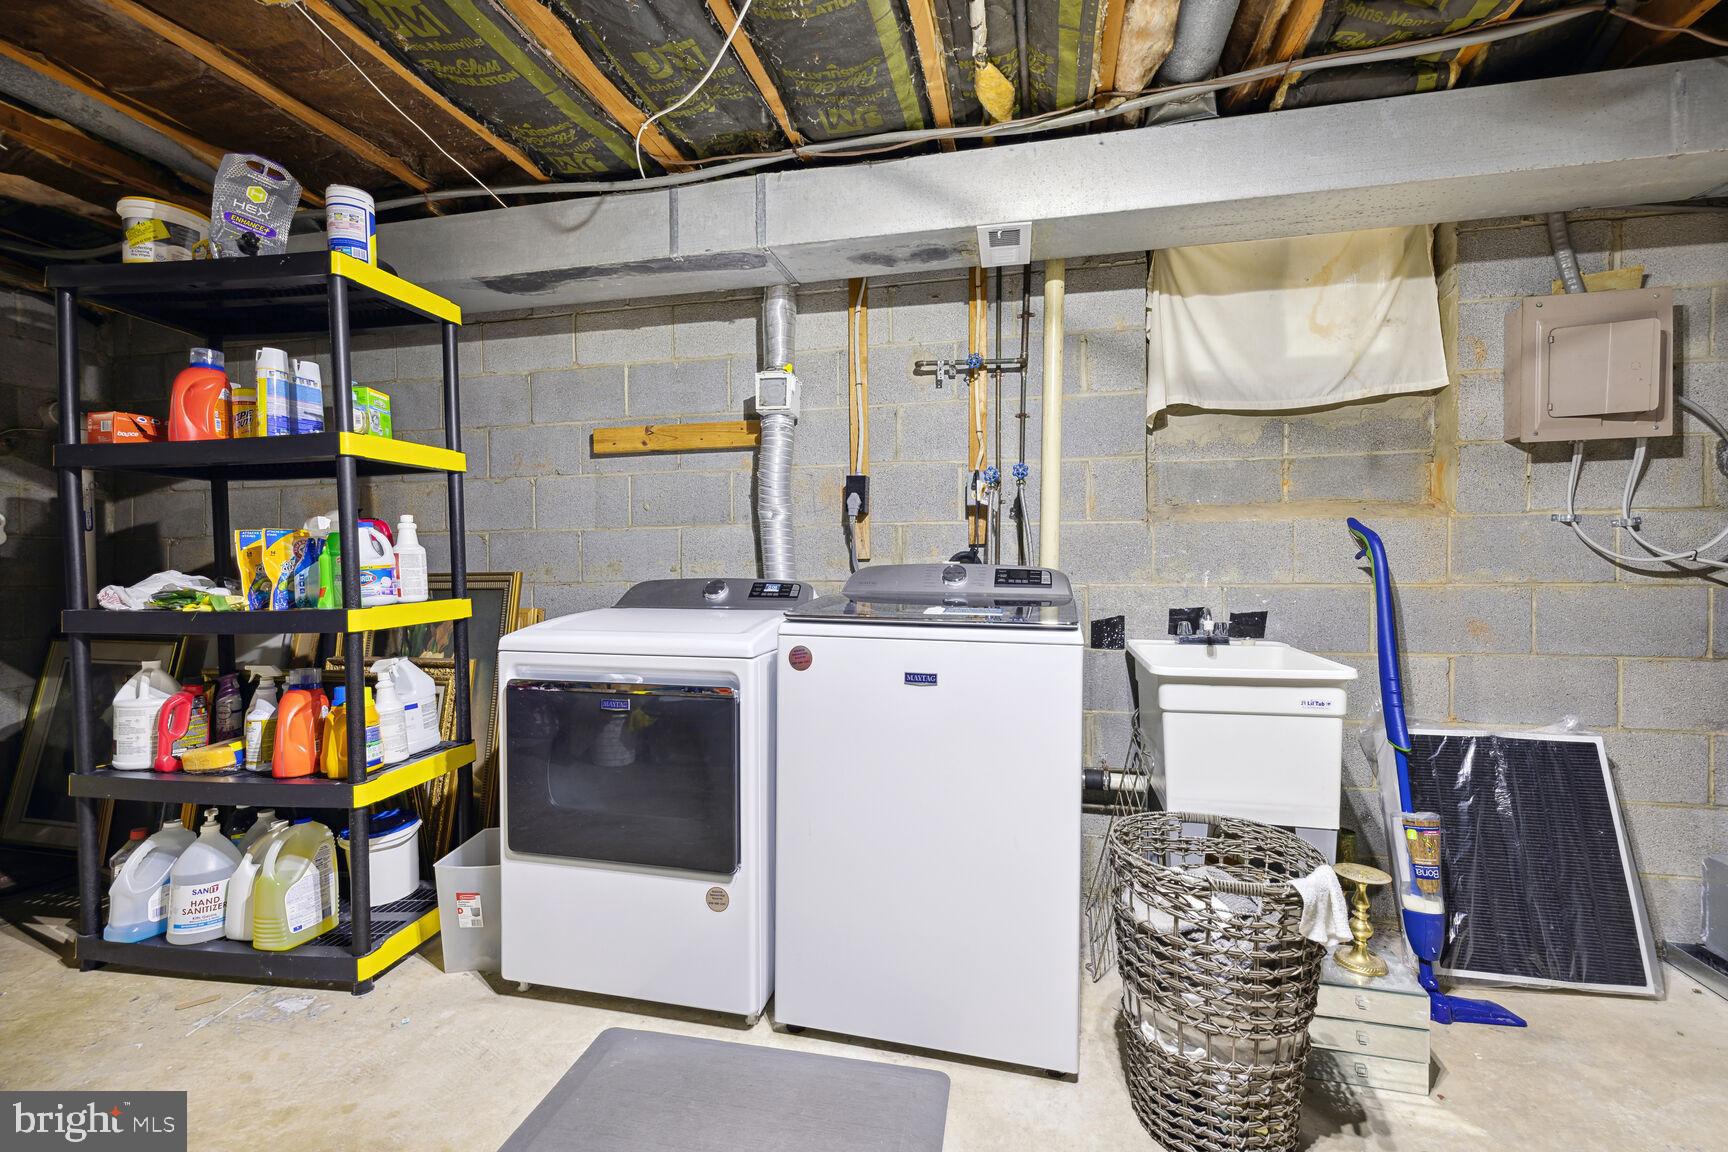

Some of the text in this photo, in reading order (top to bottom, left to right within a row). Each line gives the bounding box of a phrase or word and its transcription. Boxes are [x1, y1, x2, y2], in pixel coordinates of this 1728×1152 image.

[233, 198, 271, 220] HEX
[906, 674, 936, 682] MAYTAG
[602, 700, 628, 708] MAYTAG
[1415, 867, 1440, 879] Bona
[190, 896, 220, 908] HAND
[182, 901, 227, 916] SANITIZER
